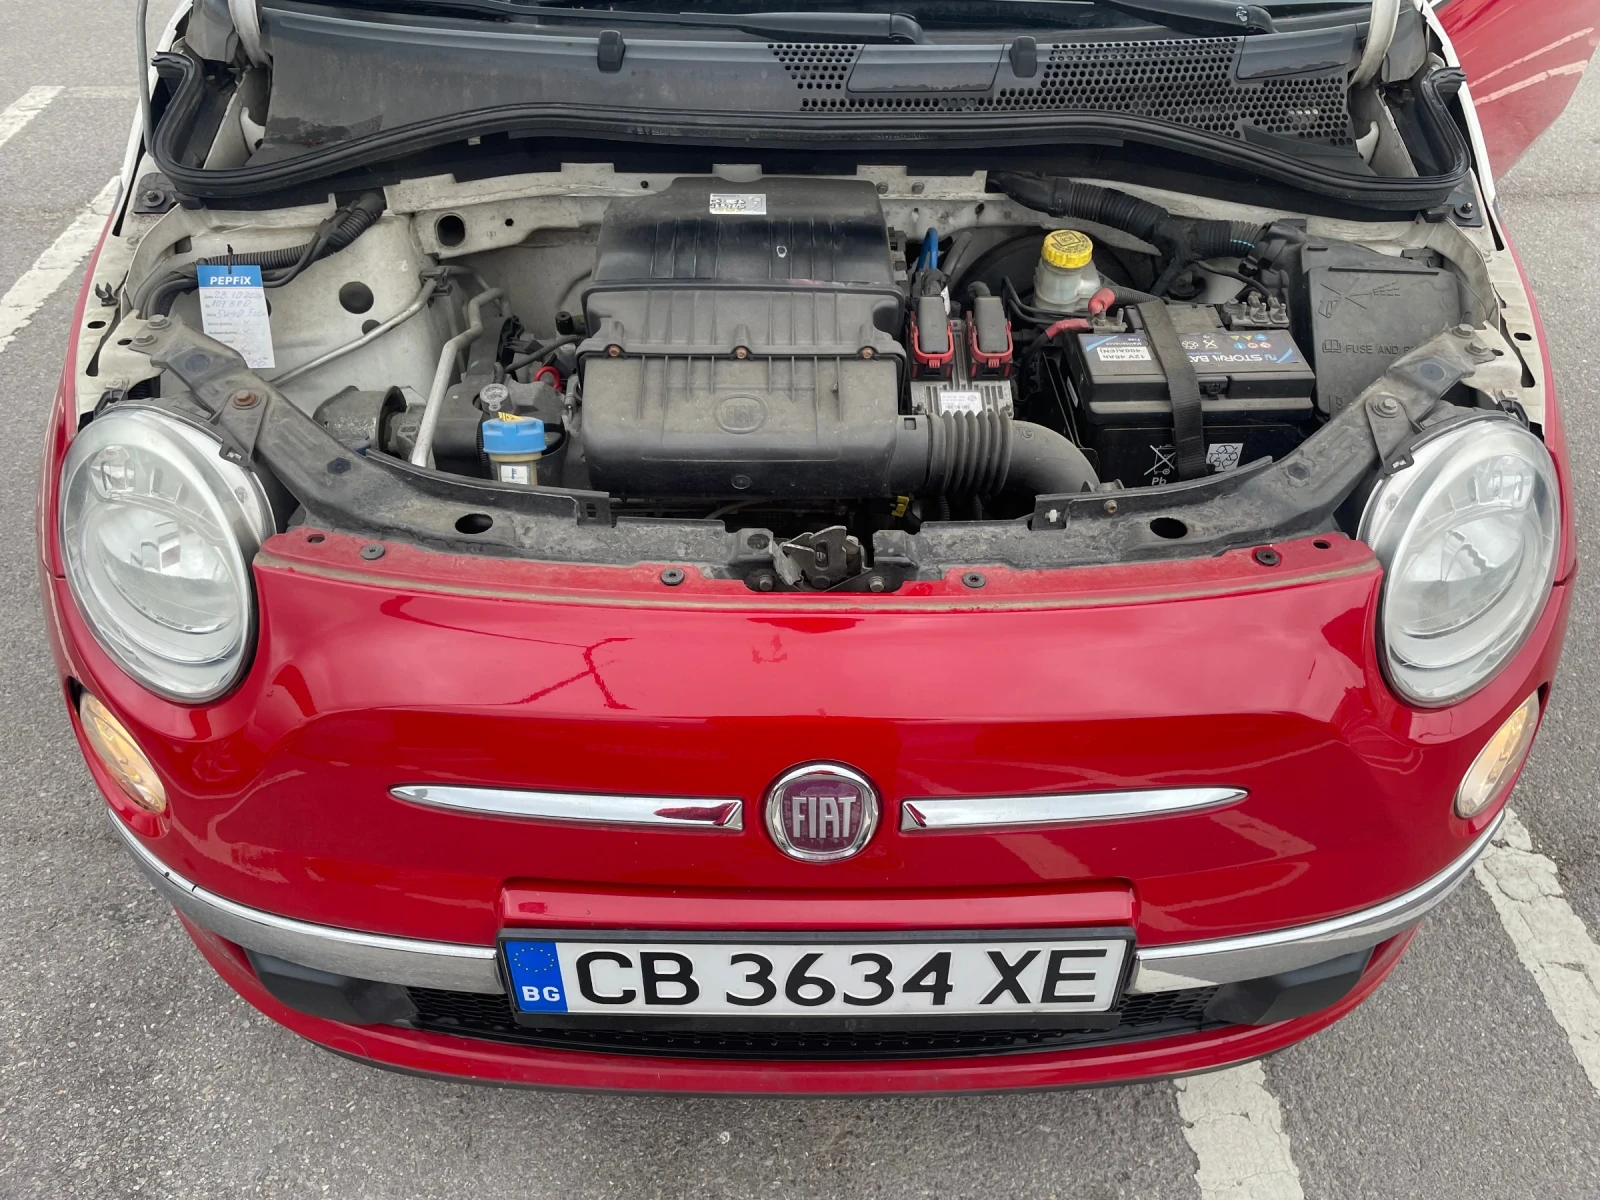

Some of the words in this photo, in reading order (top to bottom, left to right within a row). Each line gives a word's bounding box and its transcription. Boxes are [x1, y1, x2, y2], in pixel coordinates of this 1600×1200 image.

[1345, 344, 1373, 354] FUSE
[1377, 345, 1399, 355] AND
[1151, 477, 1167, 486] Pb
[792, 796, 857, 839] FIAT
[576, 951, 700, 1006] CB
[726, 951, 954, 1007] 3634
[979, 949, 1107, 1005] XE
[522, 986, 560, 1001] BG
